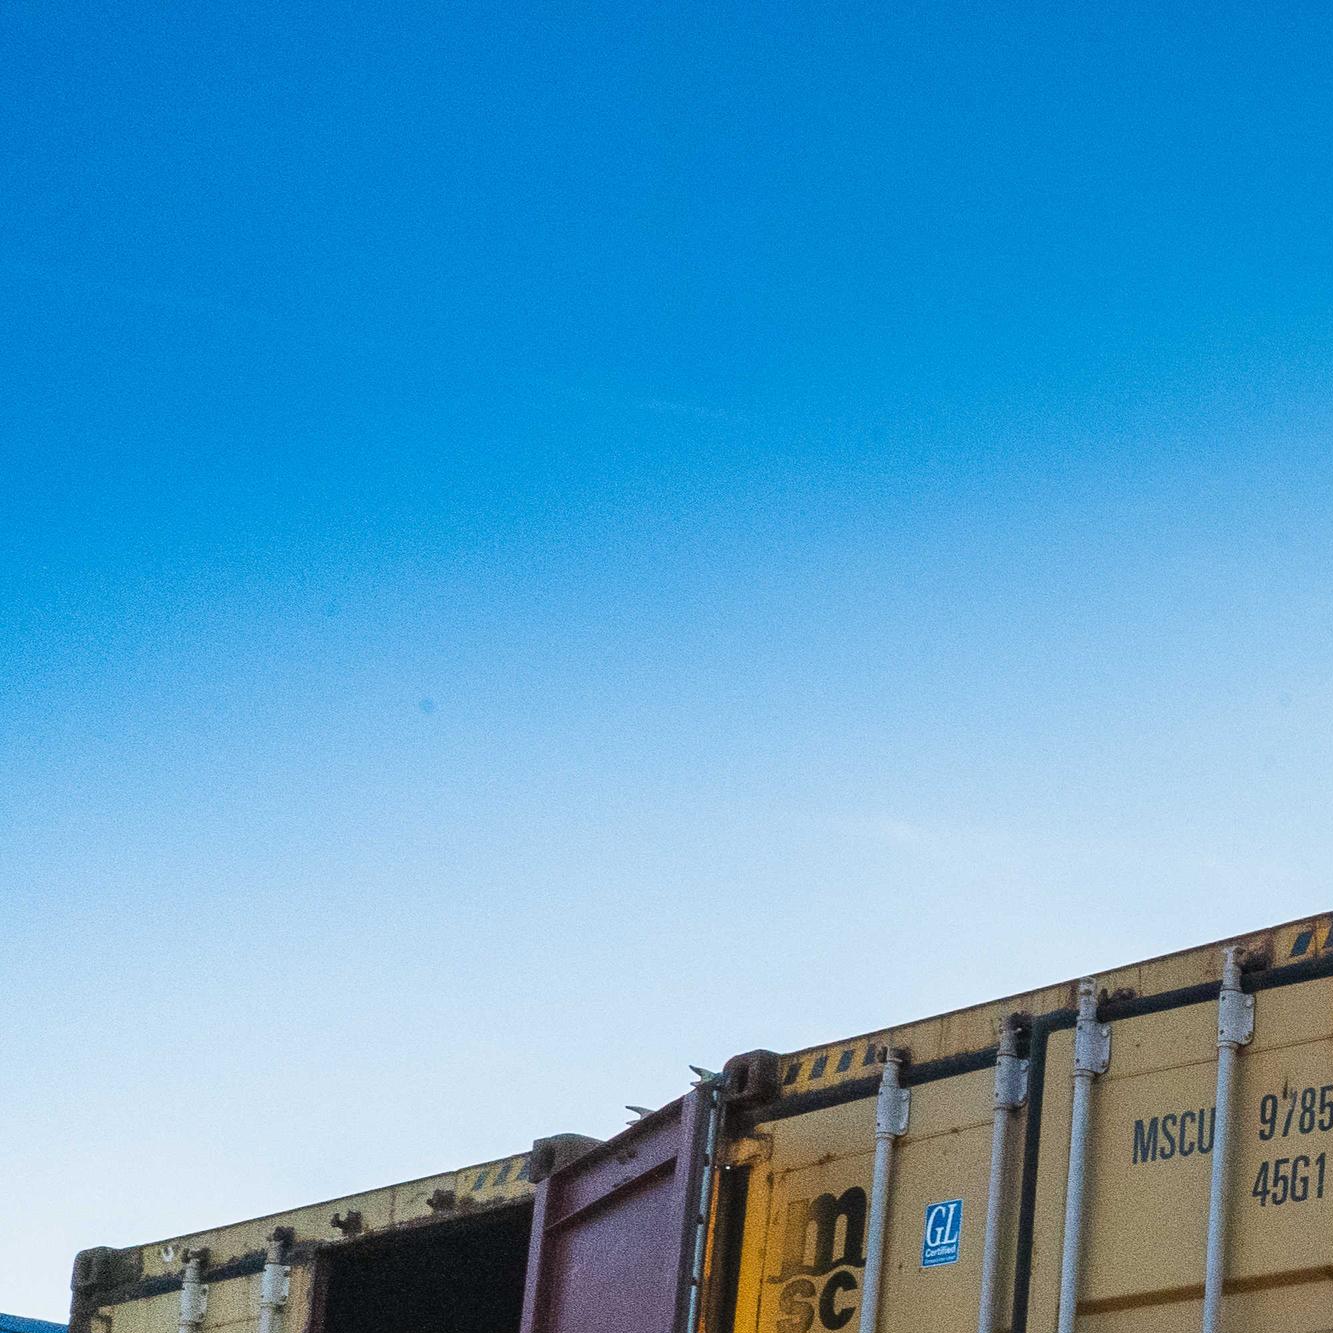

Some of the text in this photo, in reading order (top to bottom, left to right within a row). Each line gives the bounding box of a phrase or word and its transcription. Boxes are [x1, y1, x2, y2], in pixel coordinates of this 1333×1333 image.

[1133, 1105, 1215, 1164] MSCU
[1252, 1153, 1328, 1208] 45G1
[927, 1203, 957, 1247] GL
